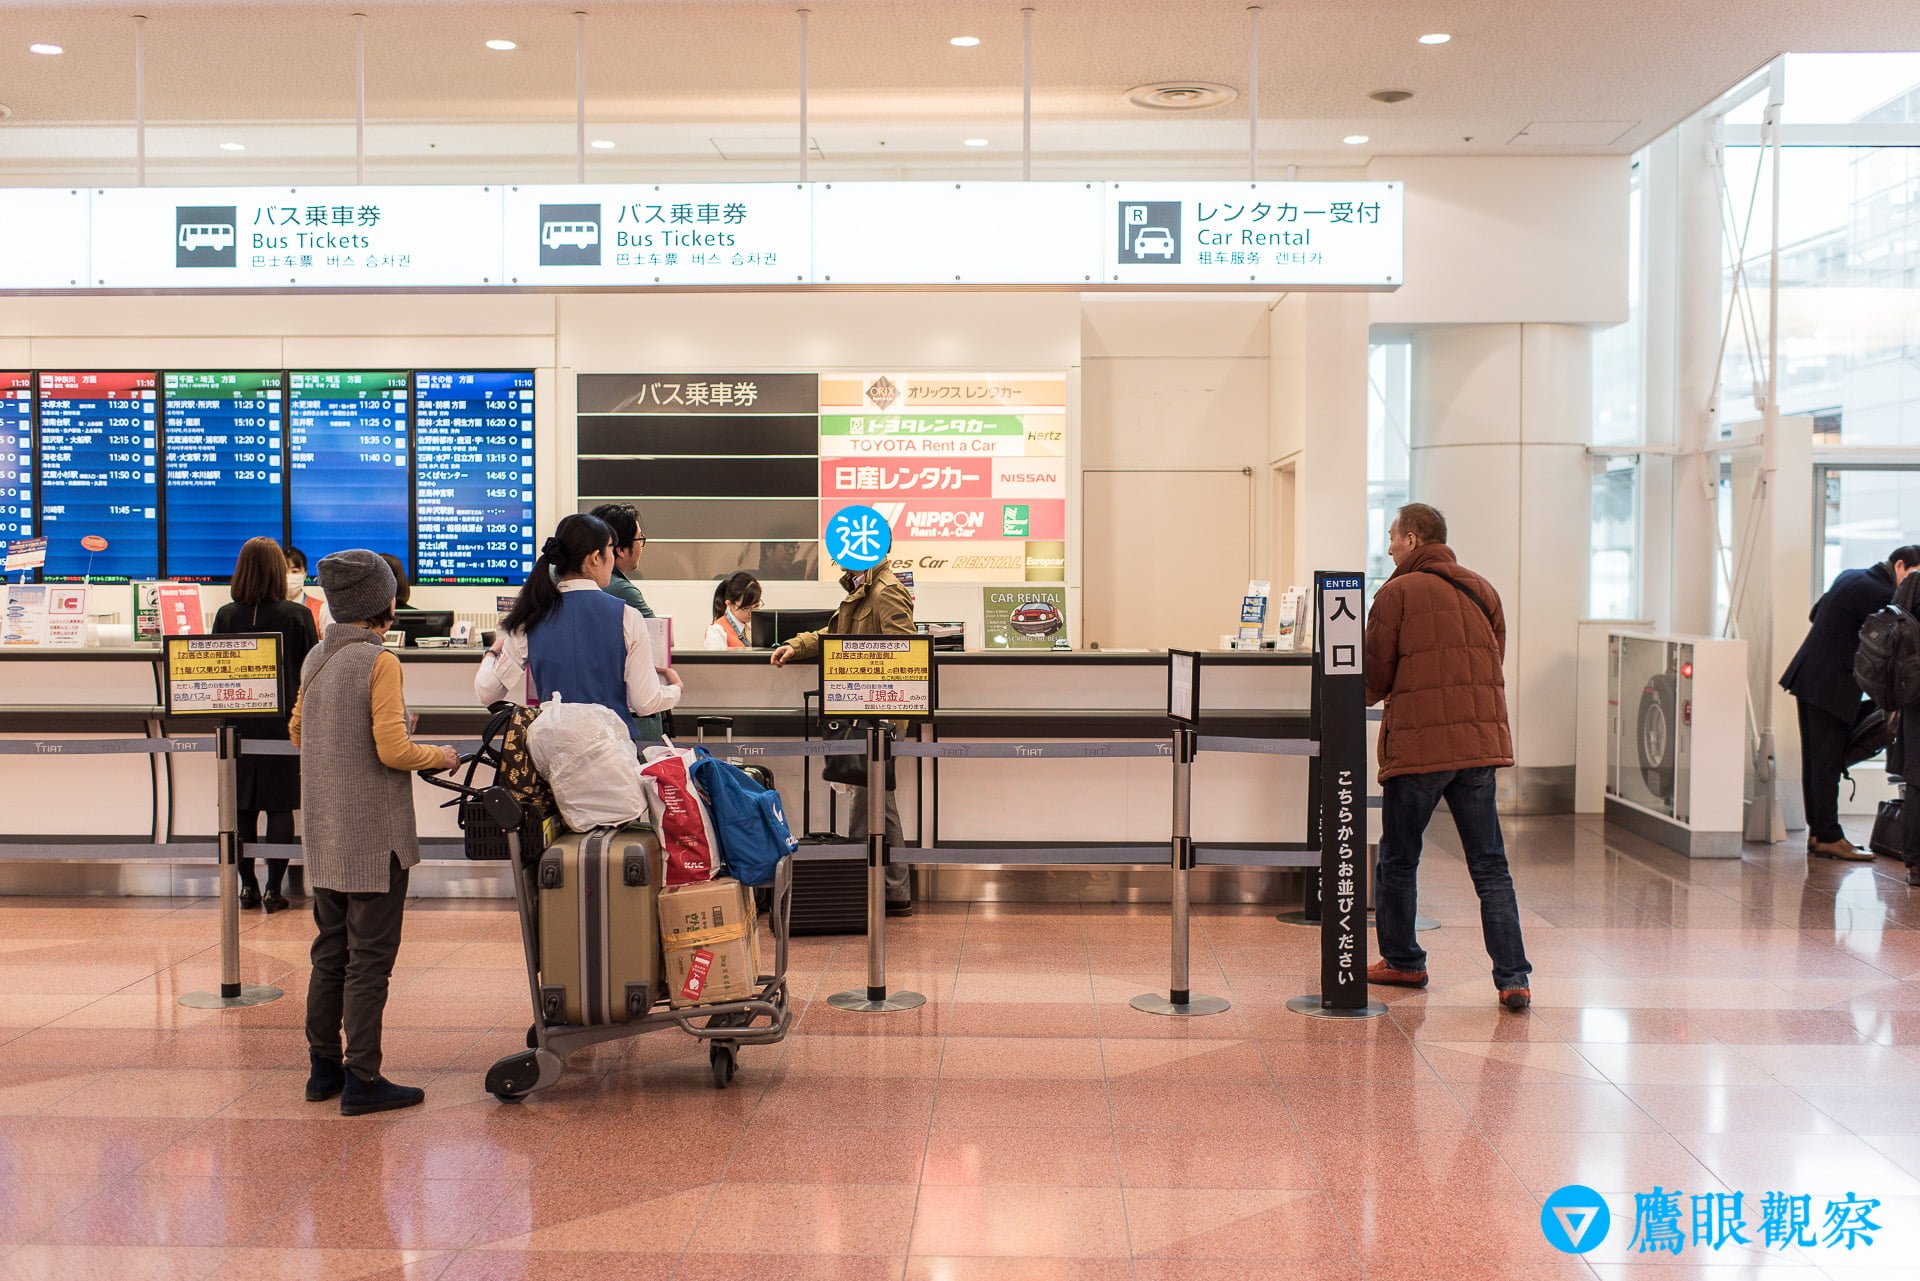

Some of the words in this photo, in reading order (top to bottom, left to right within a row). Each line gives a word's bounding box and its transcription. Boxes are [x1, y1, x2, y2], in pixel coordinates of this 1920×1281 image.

[253, 205, 381, 227] バス乗車券
[618, 203, 747, 225] バス乗車券
[1198, 202, 1381, 224] レンタカー受付
[253, 233, 288, 248] Bus
[296, 231, 369, 248] Tickets
[617, 231, 653, 247] Bus
[661, 230, 735, 247] Tickets
[1197, 229, 1233, 245] Car
[1242, 228, 1310, 245] Rental
[252, 255, 313, 267] 巴士车票
[327, 255, 356, 267] 버스
[365, 254, 411, 267] 승차권
[616, 253, 679, 266] 巴士车票
[692, 252, 721, 266] 버스
[730, 252, 776, 266] 승차권
[1199, 251, 1261, 265] 租车服务
[1276, 251, 1322, 265] 렌터카
[137, 379, 155, 387] 11:10
[261, 379, 280, 387] 11:10
[387, 379, 406, 387] 11:10
[431, 375, 453, 384] その他
[459, 375, 474, 384] 方面
[637, 382, 759, 407] バス乗車券
[870, 386, 896, 396] ORIX
[908, 386, 961, 399] オリックス
[966, 386, 1022, 399] レンタカー
[108, 401, 129, 409] 11:20
[234, 401, 254, 409] 11:25
[359, 401, 380, 409] 11:20
[486, 401, 506, 409] 14:30
[109, 418, 129, 426] 12:00
[234, 418, 255, 427] 15:10
[360, 418, 380, 427] 11:25
[486, 418, 506, 427] 16:20
[868, 419, 997, 433] トヨタレンタカー
[109, 436, 129, 444] 12:15
[234, 436, 255, 444] 12:20
[360, 436, 380, 445] 15:35
[486, 436, 506, 445] 14:25
[1027, 431, 1062, 441] Hertz
[850, 439, 917, 451] TOYOTA
[922, 439, 955, 451] Rent
[959, 443, 966, 451] a
[971, 439, 996, 451] Car
[109, 453, 130, 462] 11:40
[234, 453, 255, 462] 11:50
[360, 453, 380, 462] 11:40
[486, 454, 506, 462] 13:15
[109, 471, 130, 479] 11:50
[234, 471, 255, 479] 12:25
[418, 471, 469, 480] つくばセンター
[486, 471, 506, 480] 14:45
[835, 467, 980, 490] 日産レンタカー
[1000, 473, 1057, 483] NISSAN
[486, 489, 506, 497] 14:55
[109, 506, 130, 514] 11:45
[905, 511, 984, 528] NIPPON
[486, 524, 506, 533] 12:05
[486, 542, 507, 550] 12:25
[487, 559, 507, 568] 13:40
[918, 556, 948, 568] Car
[952, 556, 1022, 569] RENTAL
[1326, 579, 1359, 588] ENTER
[990, 593, 1014, 603] CAR
[1017, 593, 1061, 603] RENTAL
[1329, 596, 1356, 667] 入口
[190, 641, 255, 649] お急ぎのお客さまへ
[844, 641, 908, 650] お急ぎのお客さまへ
[1337, 771, 1354, 985] こちらからお並びください
